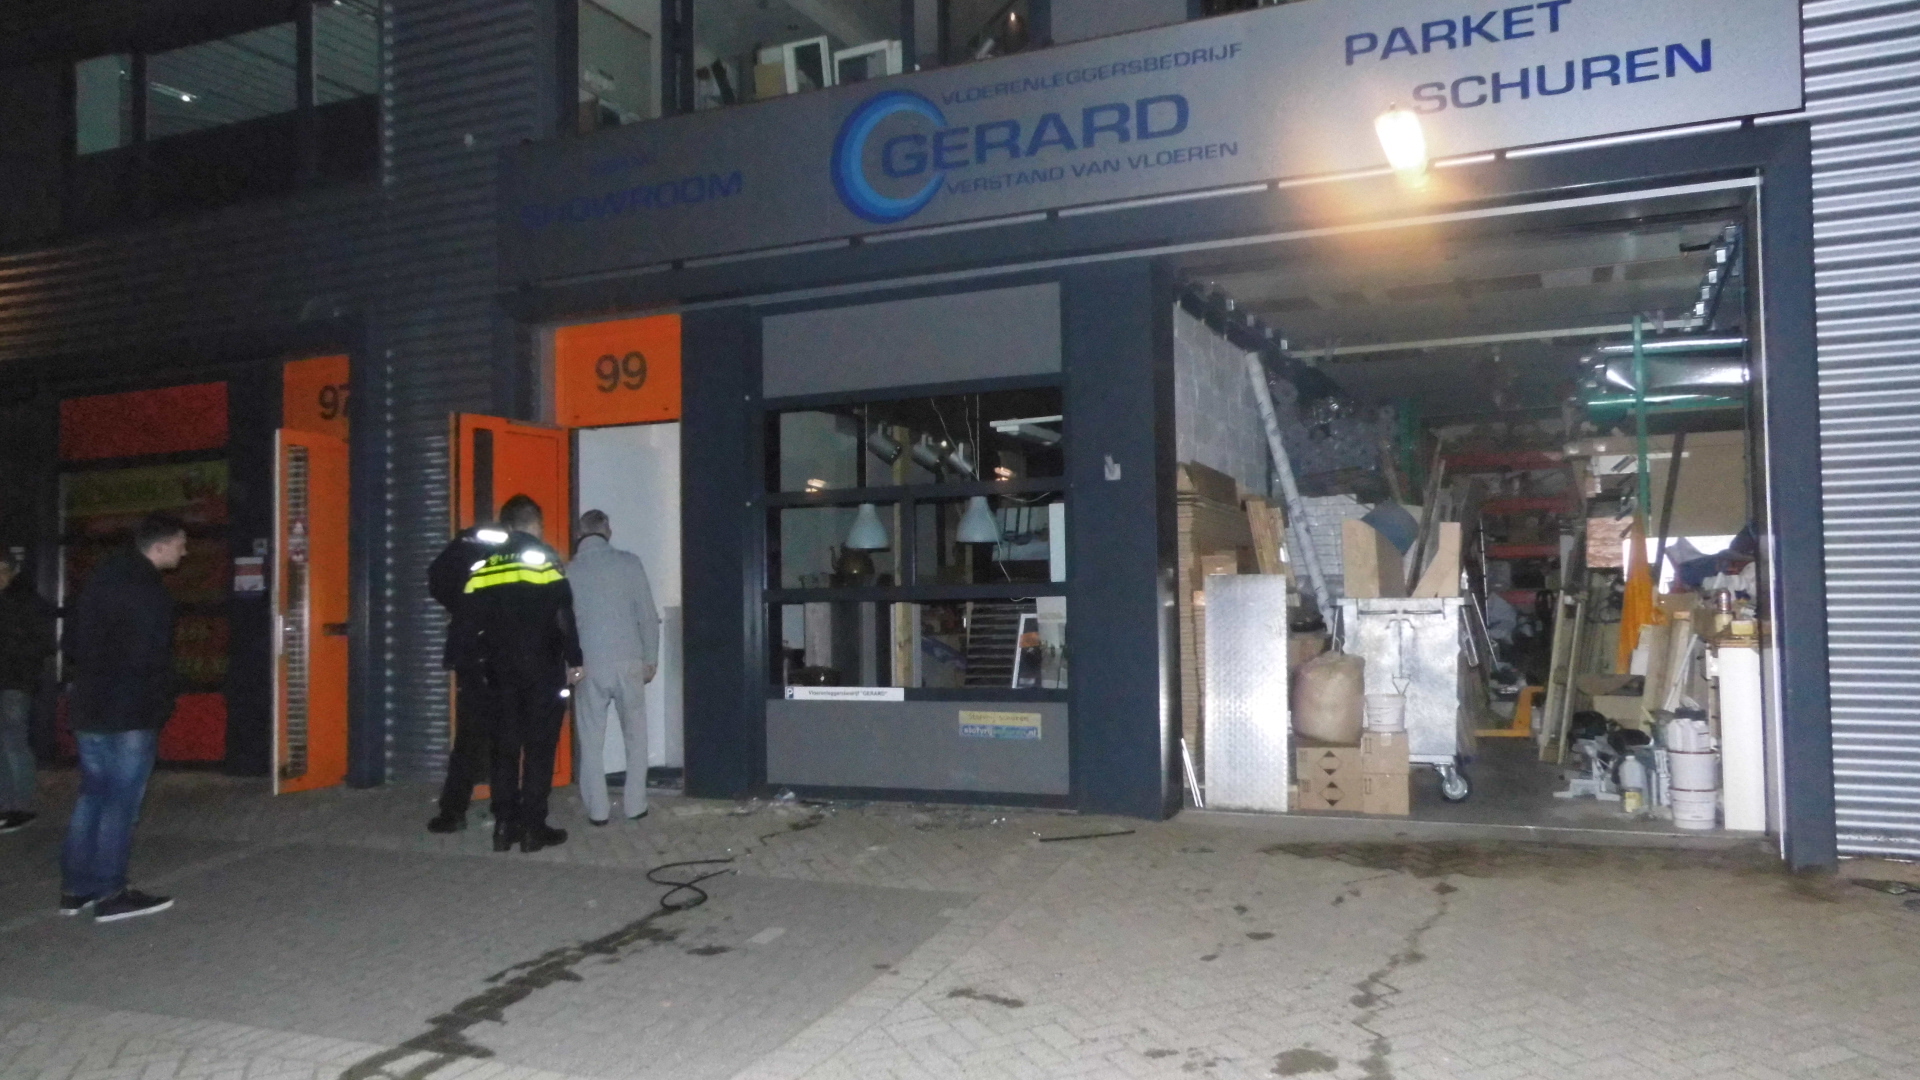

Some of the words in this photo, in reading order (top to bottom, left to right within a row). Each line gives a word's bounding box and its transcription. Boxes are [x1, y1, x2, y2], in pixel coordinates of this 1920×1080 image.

[1345, 0, 1571, 65] PARKET
[942, 42, 1243, 105] VLOERENLEGGERSBEDRIJF
[1411, 38, 1712, 115] SCHUREN
[882, 93, 1189, 178] GERARD
[521, 170, 743, 229] SHOWROOM
[945, 166, 1066, 195] VERSTAND
[1072, 159, 1121, 180] VAN
[1127, 141, 1238, 170] VLOEREN
[595, 351, 647, 393] 99
